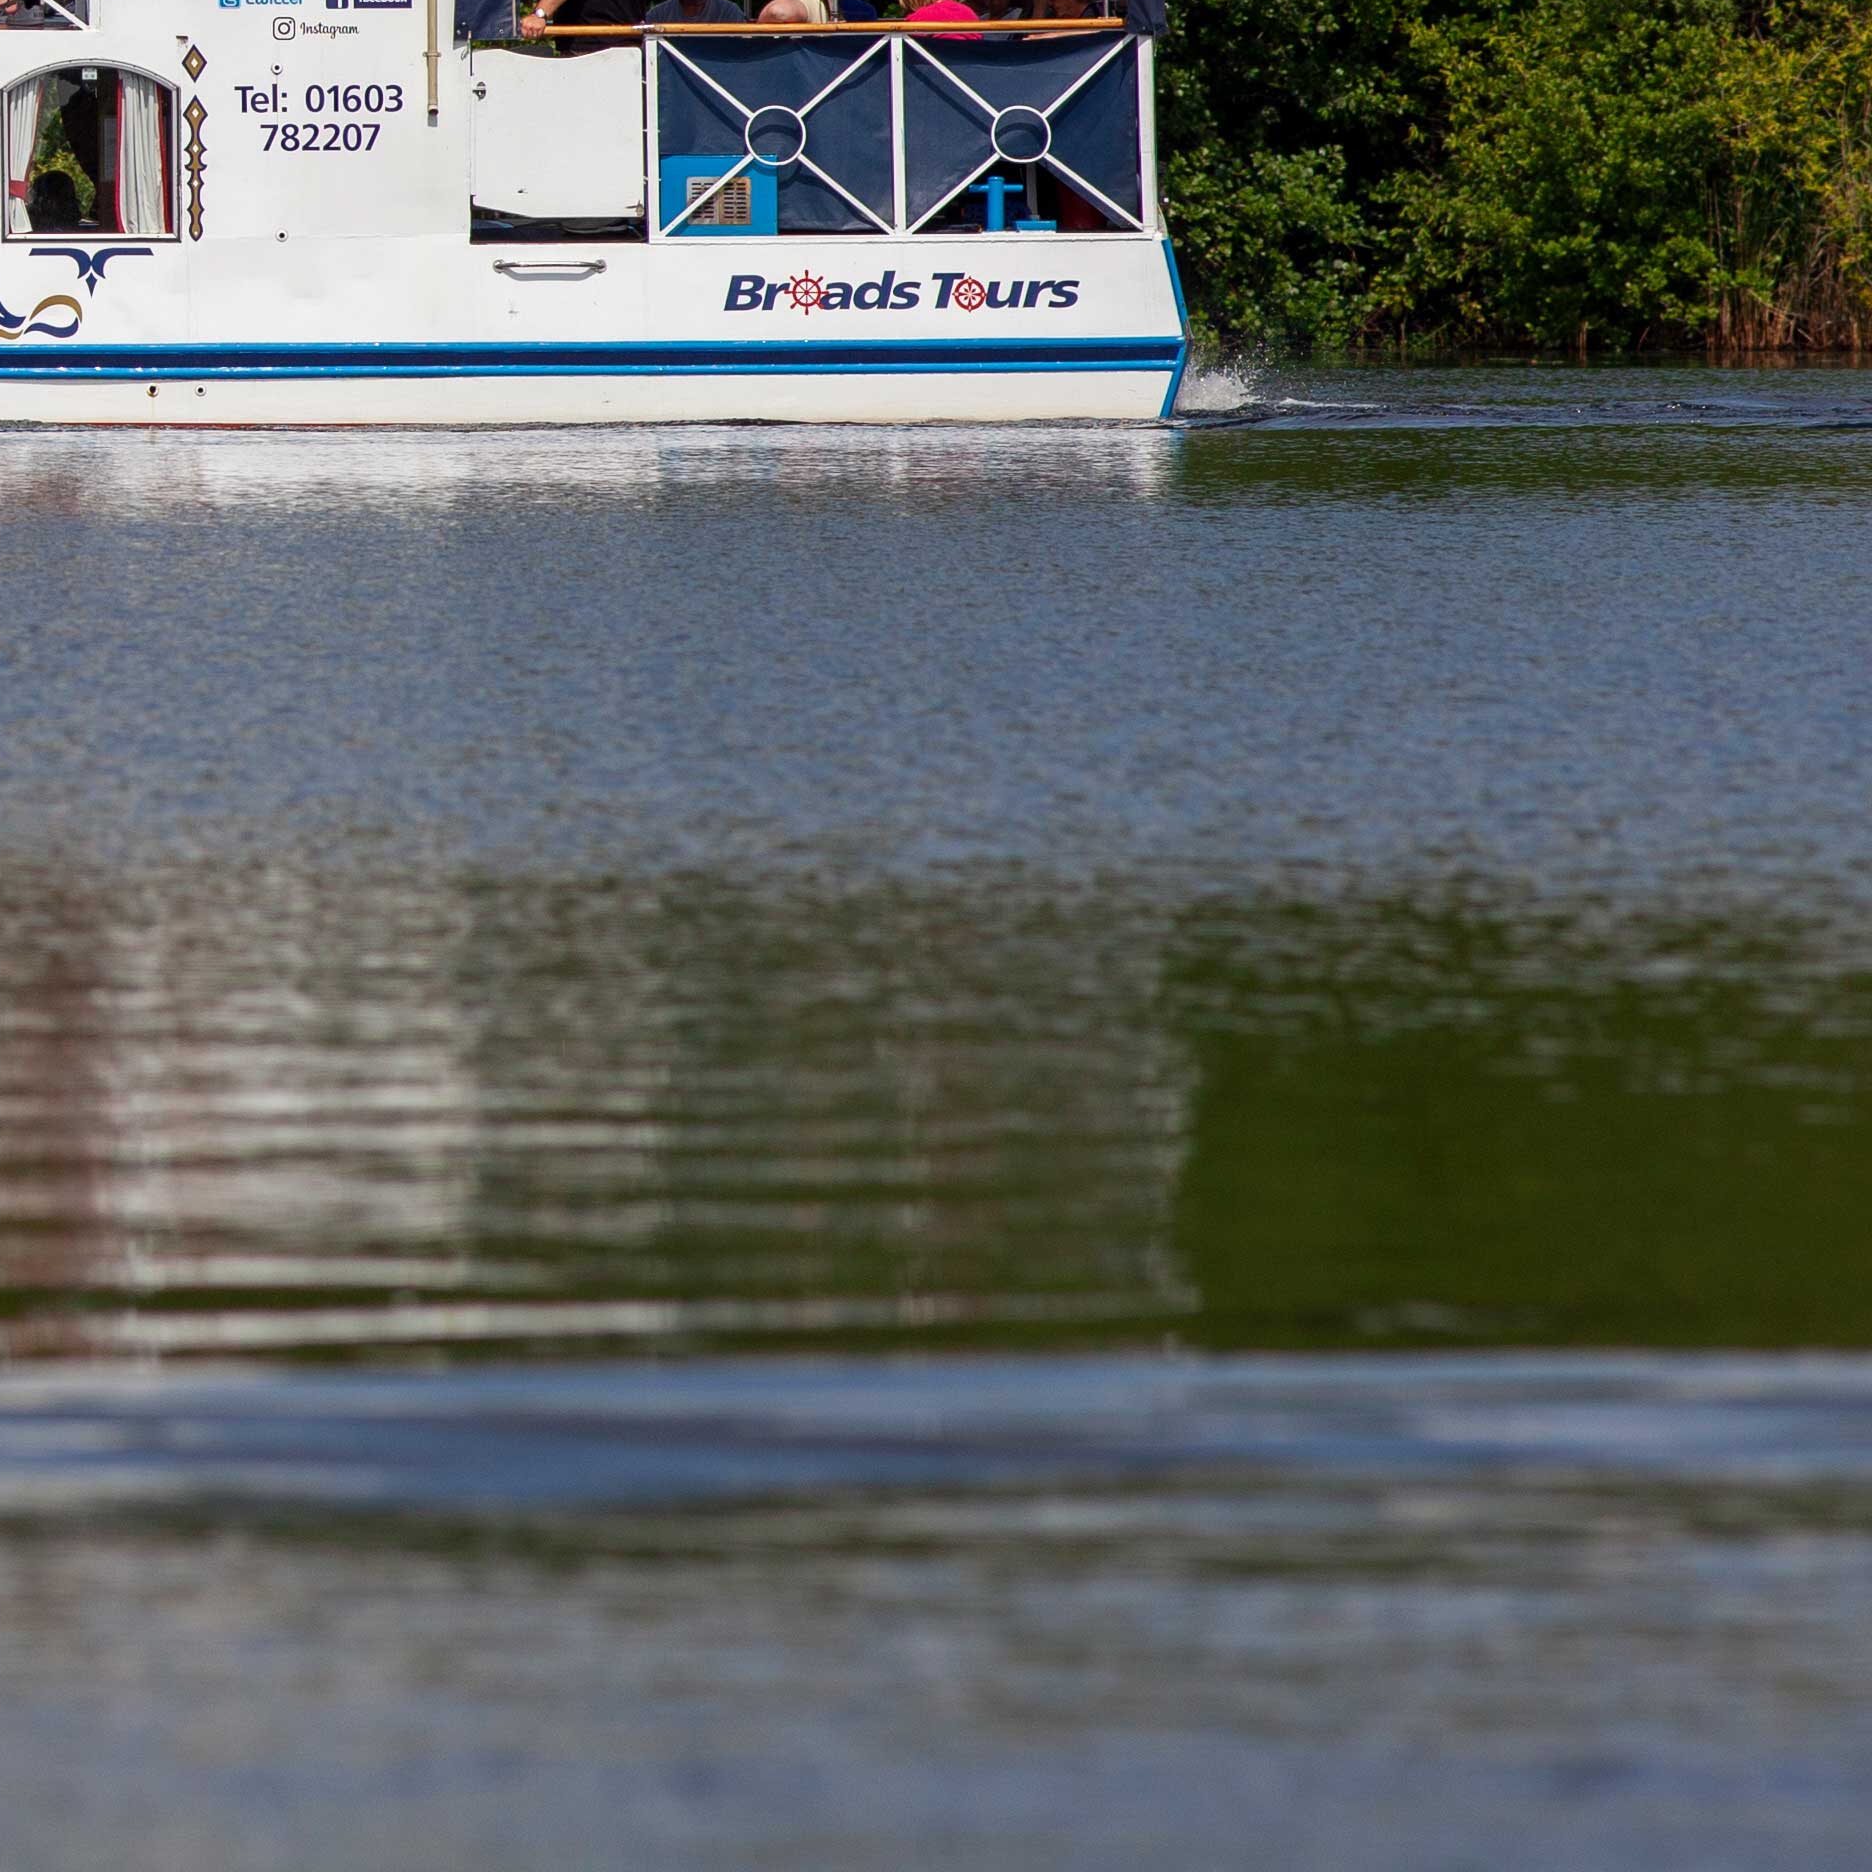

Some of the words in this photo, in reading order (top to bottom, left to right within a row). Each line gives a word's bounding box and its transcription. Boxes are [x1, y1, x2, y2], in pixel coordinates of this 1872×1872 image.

[300, 21, 359, 39] Instagram
[234, 83, 288, 113] Tel:
[305, 84, 403, 113] 01603
[260, 123, 381, 152] 782207
